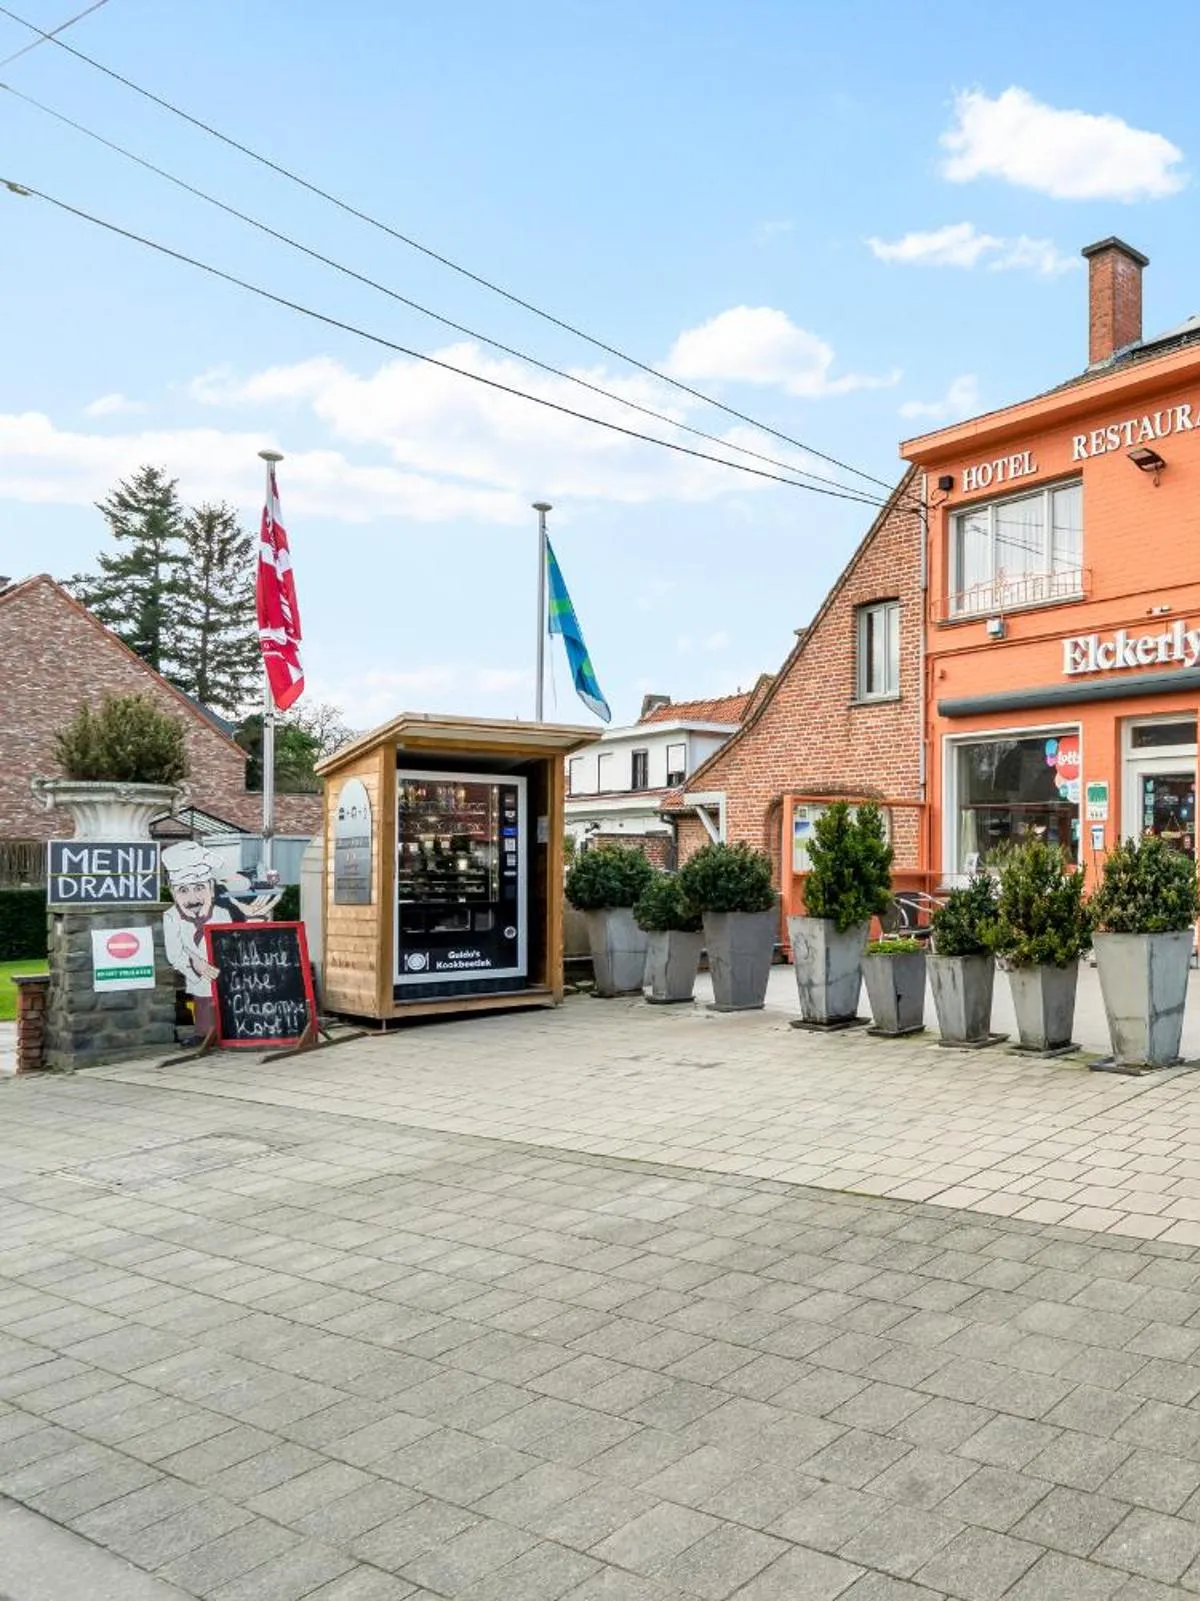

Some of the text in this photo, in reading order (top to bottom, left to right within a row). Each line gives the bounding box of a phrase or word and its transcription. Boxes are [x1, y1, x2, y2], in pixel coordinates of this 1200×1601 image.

[962, 450, 1038, 492] HOTEL
[61, 847, 156, 874] MENU
[58, 875, 153, 898] DRANK
